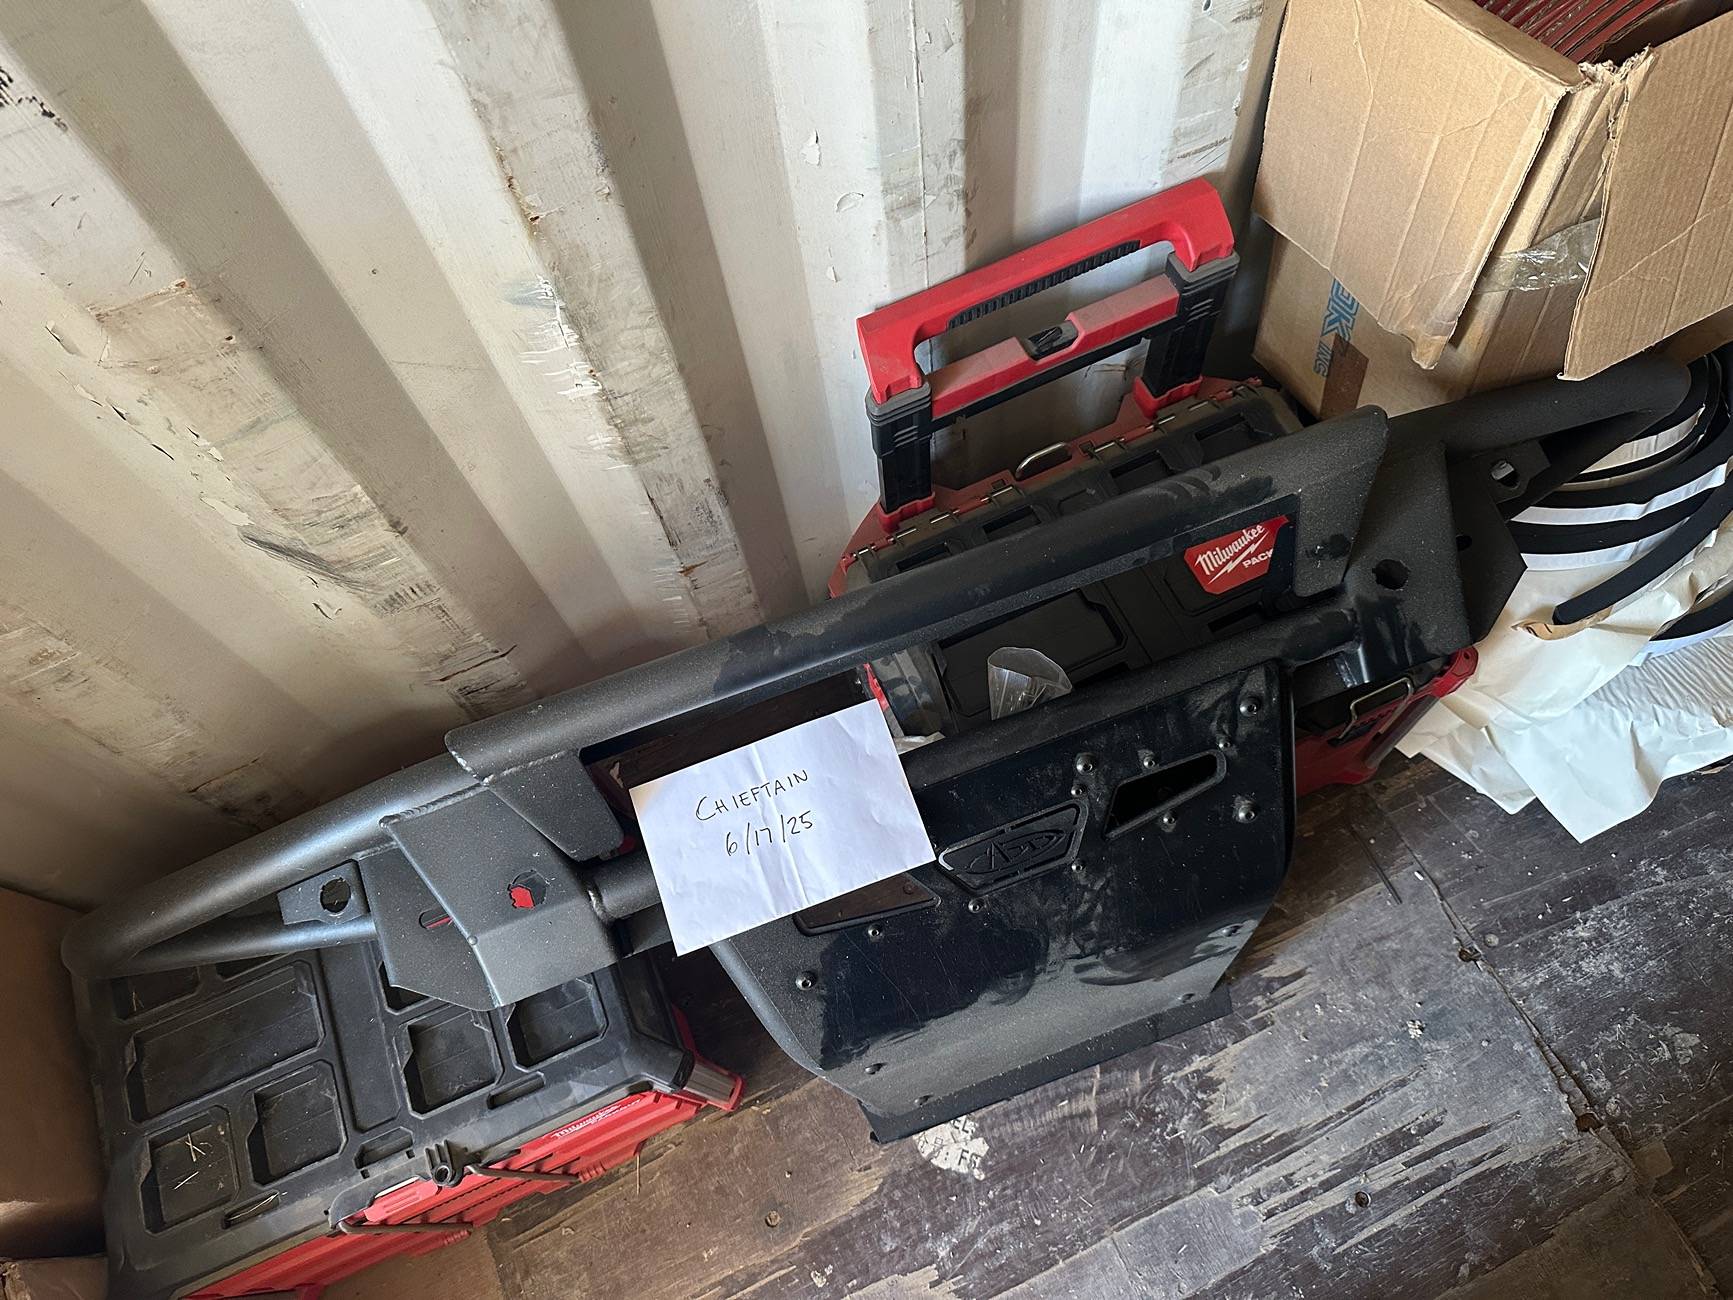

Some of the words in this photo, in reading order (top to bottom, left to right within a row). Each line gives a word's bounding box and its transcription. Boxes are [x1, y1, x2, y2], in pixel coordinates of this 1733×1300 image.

[1312, 340, 1332, 377] INC
[1193, 524, 1266, 576] Milwaukee
[695, 769, 808, 821] CHIEFTAIN
[725, 810, 813, 857] 6/17/25
